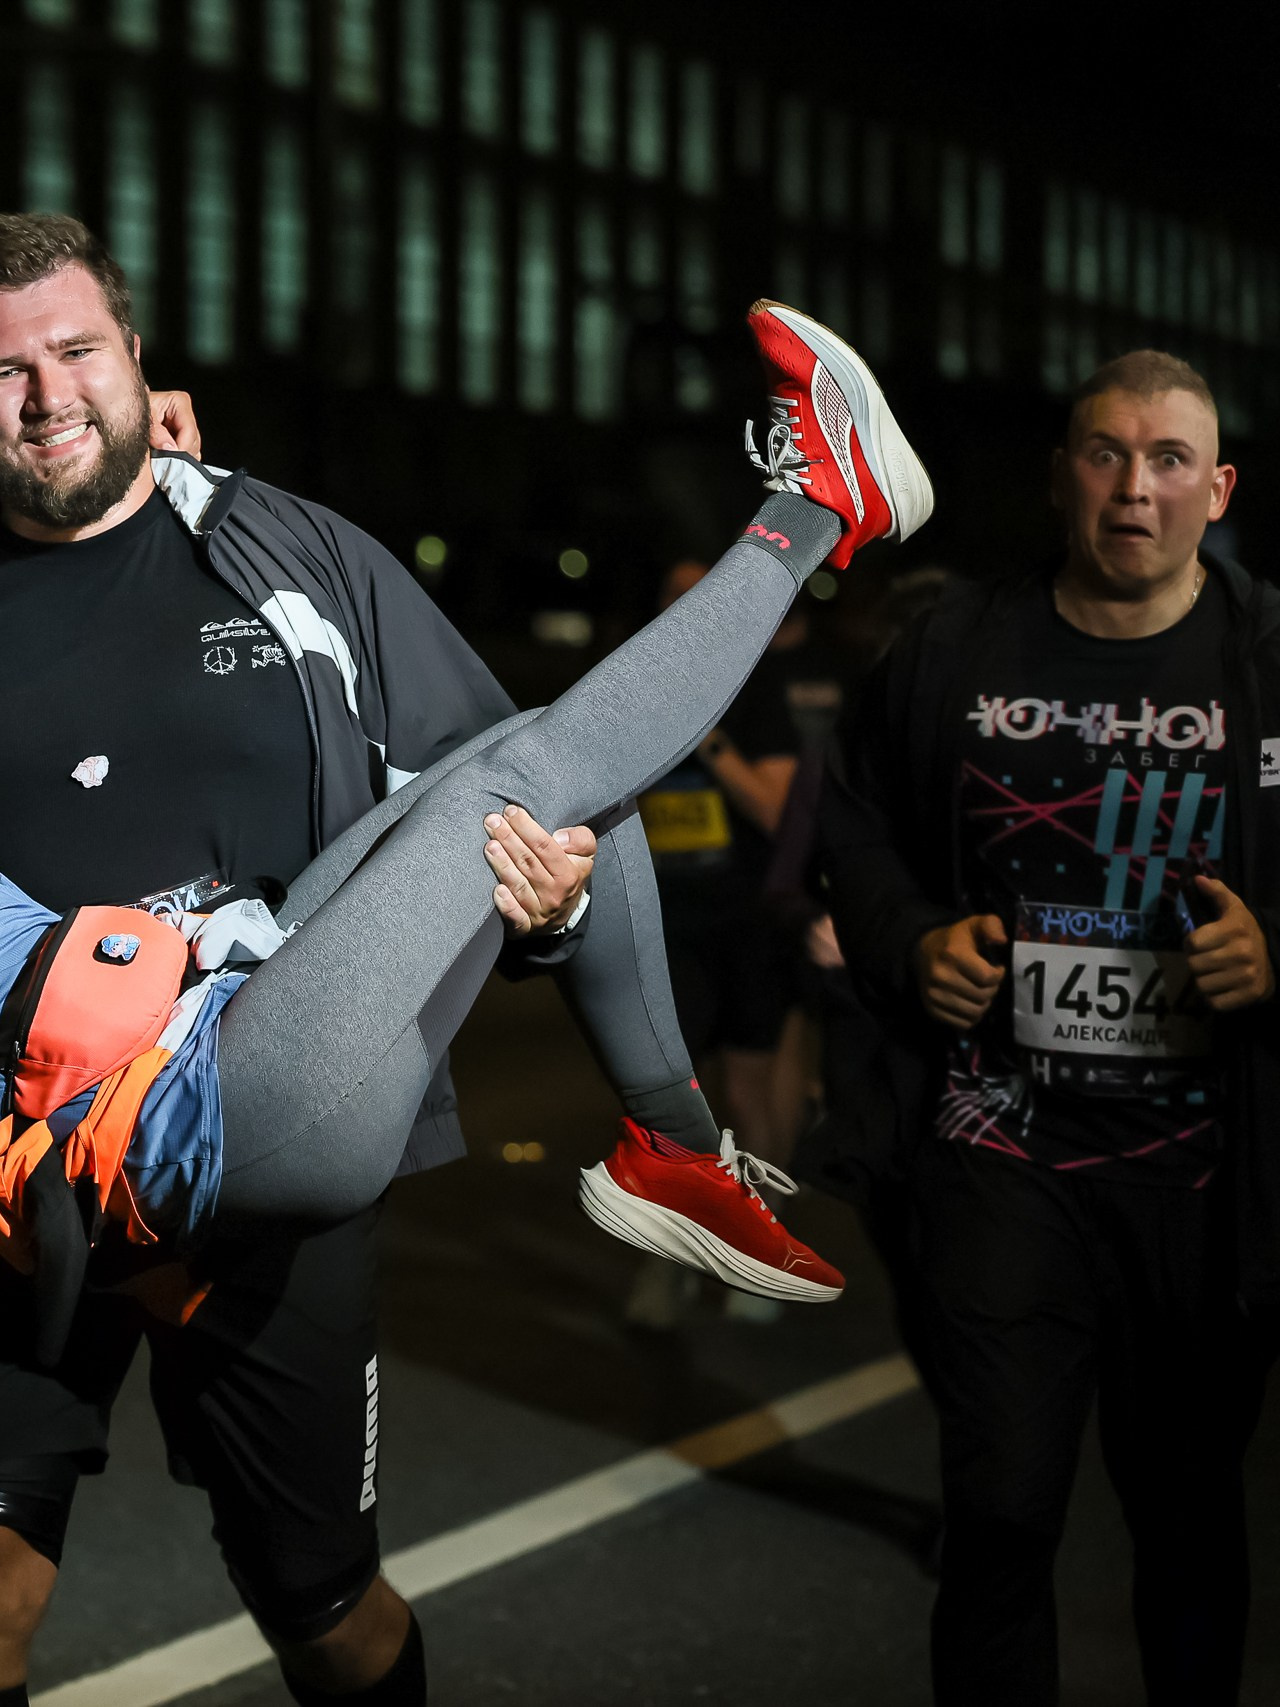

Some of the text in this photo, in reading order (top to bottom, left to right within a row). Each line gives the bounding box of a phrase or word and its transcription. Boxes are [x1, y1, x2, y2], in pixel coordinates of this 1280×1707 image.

[201, 627, 271, 643] QUIKSILVE
[1084, 749, 1207, 769] ЗАБЕГ
[360, 1353, 380, 1512] PUMA
